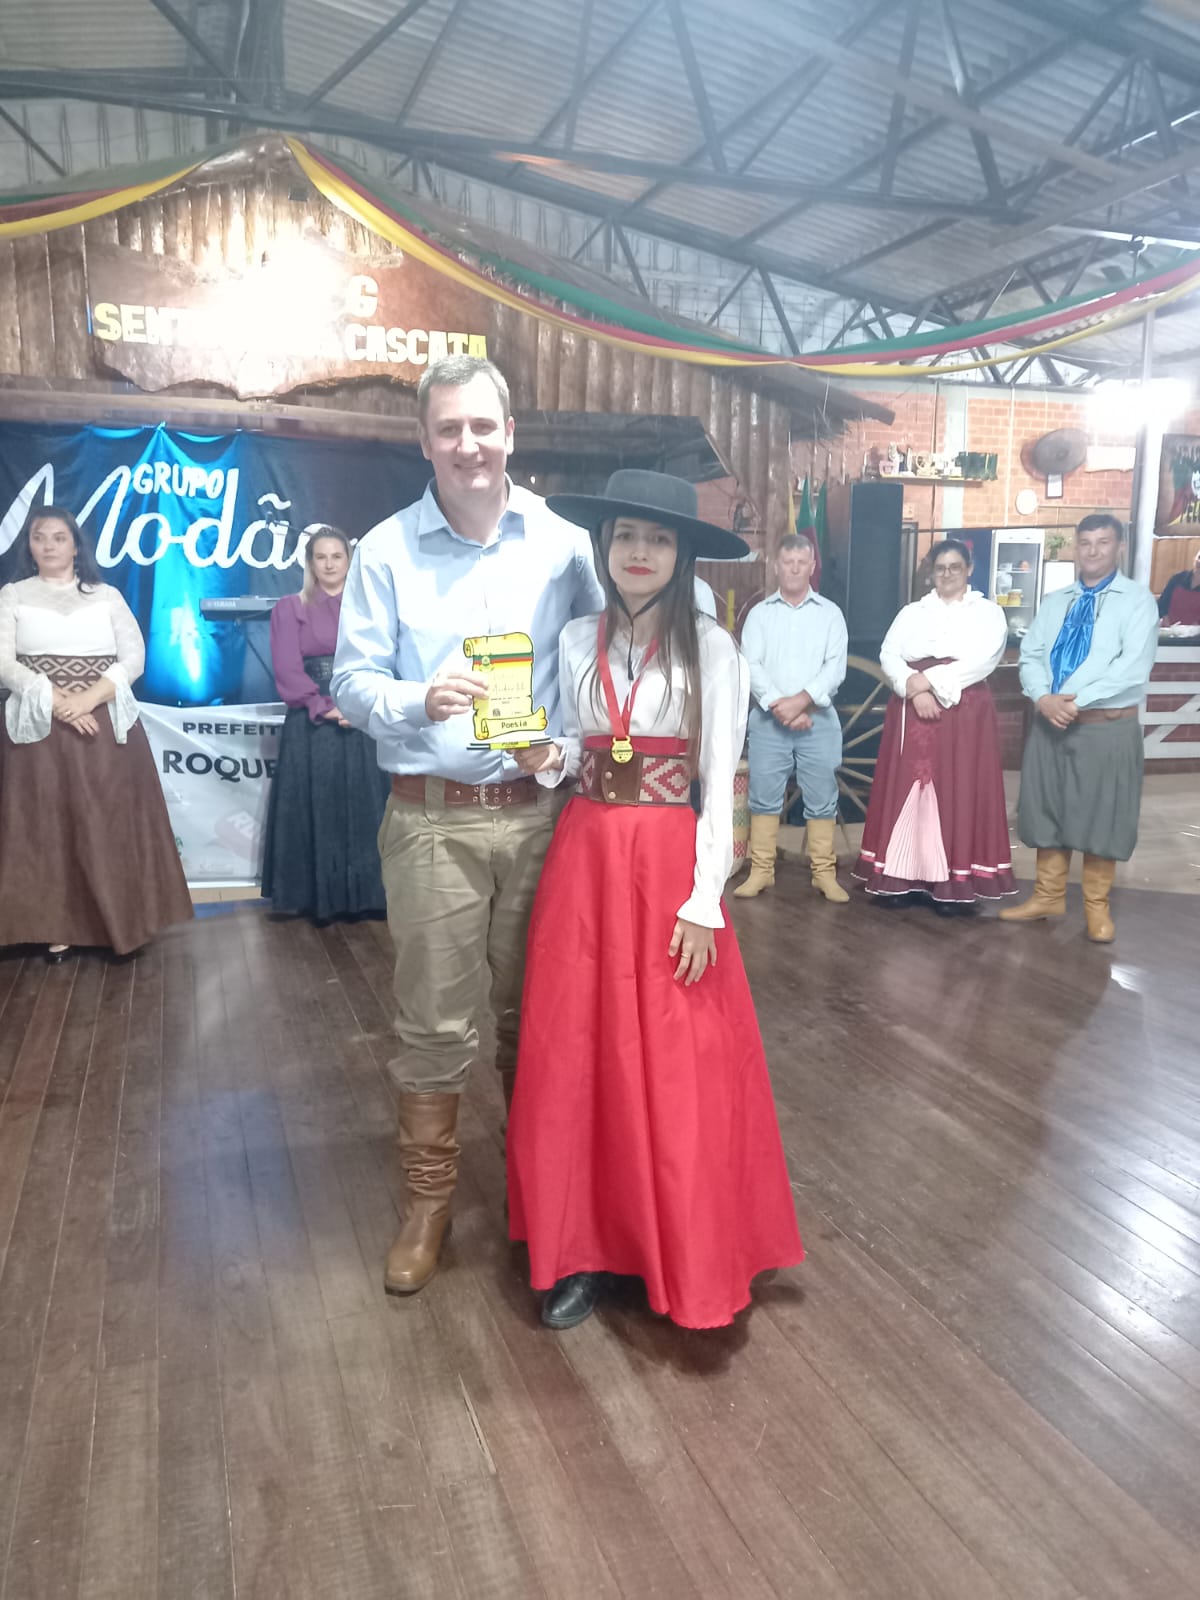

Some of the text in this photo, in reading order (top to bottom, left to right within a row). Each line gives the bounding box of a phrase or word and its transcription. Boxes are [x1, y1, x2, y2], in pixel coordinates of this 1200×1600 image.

[345, 324, 487, 366] CASCATA
[133, 461, 224, 498] GRUPO
[501, 720, 528, 730] Poesia
